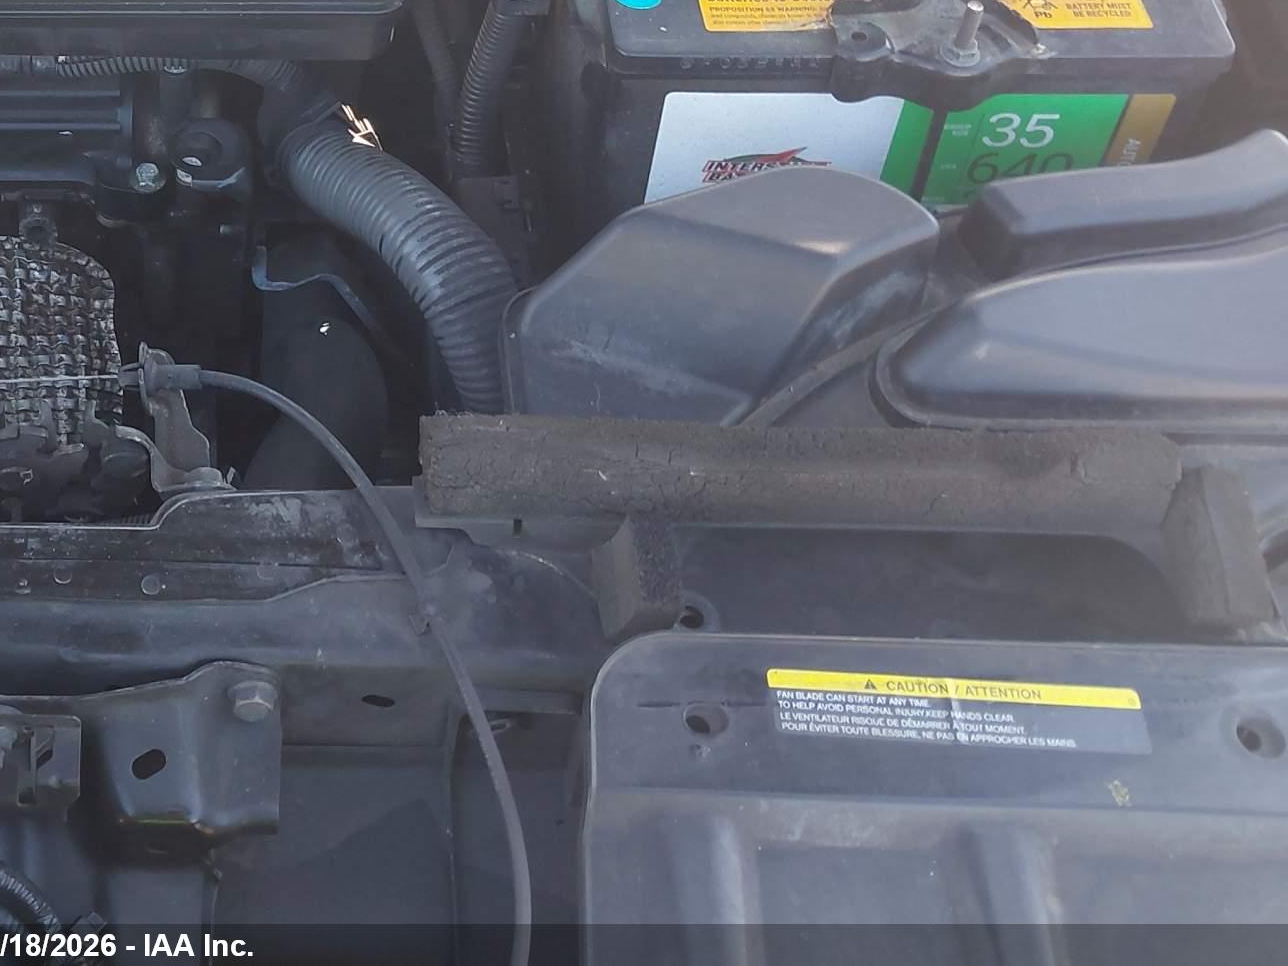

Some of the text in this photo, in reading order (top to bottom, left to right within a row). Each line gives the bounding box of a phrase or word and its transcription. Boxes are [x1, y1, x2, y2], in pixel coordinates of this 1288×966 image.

[1034, 11, 1052, 19] Pb
[1065, 2, 1104, 10] BATTERY
[982, 113, 1061, 148] 35
[776, 691, 794, 699] FAN
[796, 692, 824, 701] BLADE
[826, 694, 845, 702] CAN
[847, 696, 874, 704] START
[876, 697, 886, 705] AT
[888, 698, 906, 706] ANY
[886, 680, 949, 694] CAUTION
[964, 686, 1042, 700] ATTENTION
[778, 701, 791, 709] TO
[792, 701, 815, 711] HELP
[816, 703, 844, 712] AVOID
[845, 705, 893, 715] PERSONAL
[925, 710, 948, 719] KEEP
[951, 711, 982, 721] HANDS
[780, 713, 790, 721] LE
[792, 713, 850, 724] VENTILATEUR
[851, 717, 885, 727] RISQUE
[886, 719, 899, 727] DE
[900, 719, 950, 729] DÉMARRER
[961, 723, 984, 732] TOUT
[781, 722, 807, 732] POUR
[808, 722, 839, 733] ÉVITER
[840, 726, 869, 735] TOUTE
[922, 731, 935, 740] NE
[936, 732, 955, 741] PAS
[970, 734, 1027, 745] APPROCHER
[1028, 738, 1045, 746] LES
